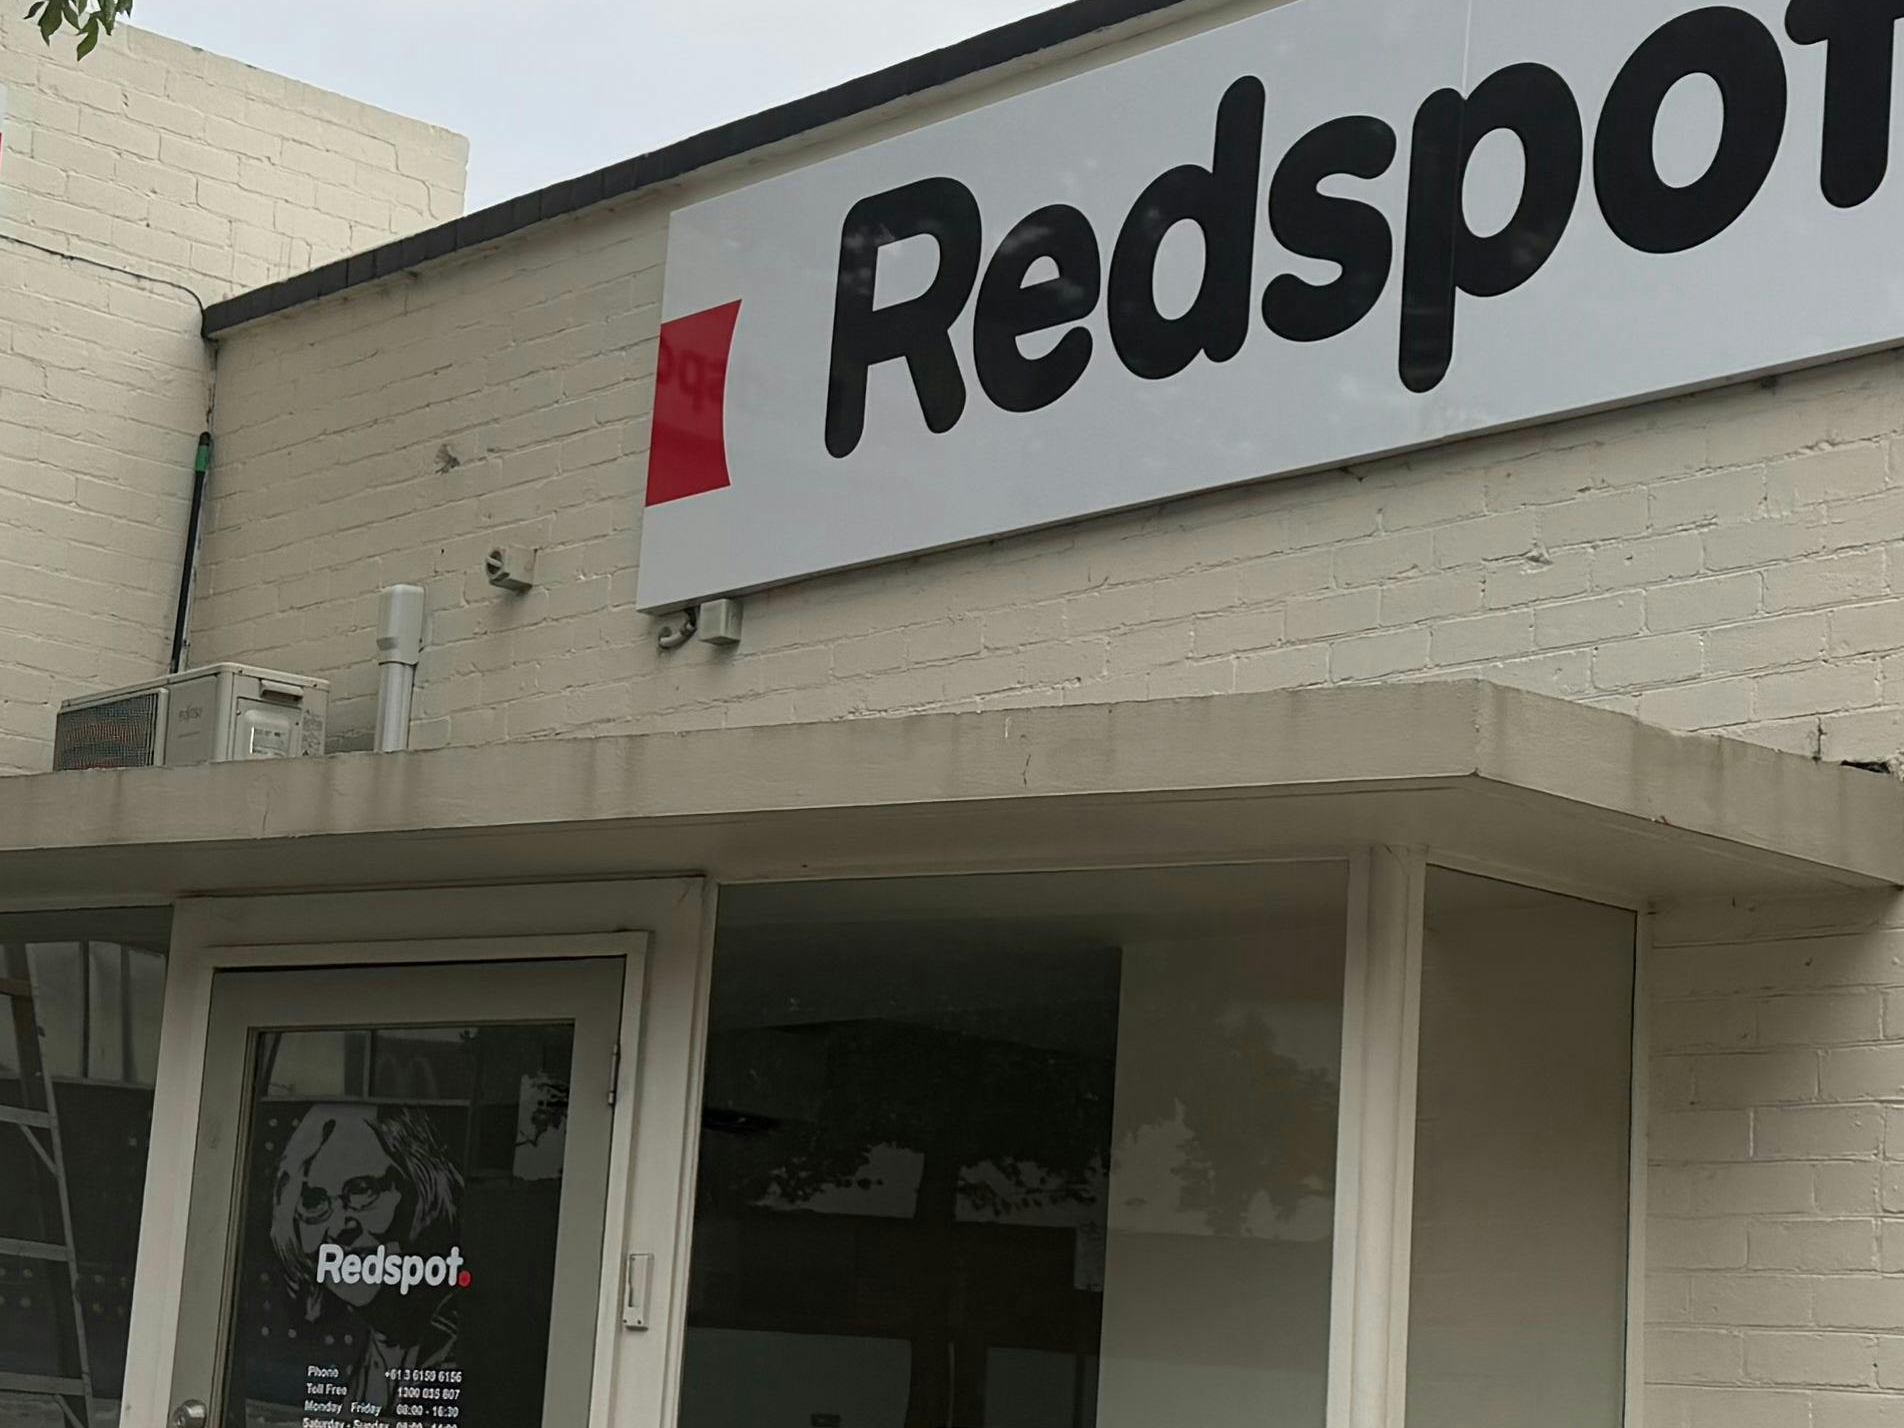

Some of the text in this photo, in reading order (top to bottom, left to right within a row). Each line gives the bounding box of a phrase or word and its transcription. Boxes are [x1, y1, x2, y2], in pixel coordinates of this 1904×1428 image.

[316, 1244, 472, 1295] Redspot.
[307, 1365, 339, 1378] Phone
[306, 1382, 323, 1395] Toll
[325, 1383, 348, 1396] Free
[304, 1399, 343, 1414] Monday
[350, 1401, 382, 1417] Friday
